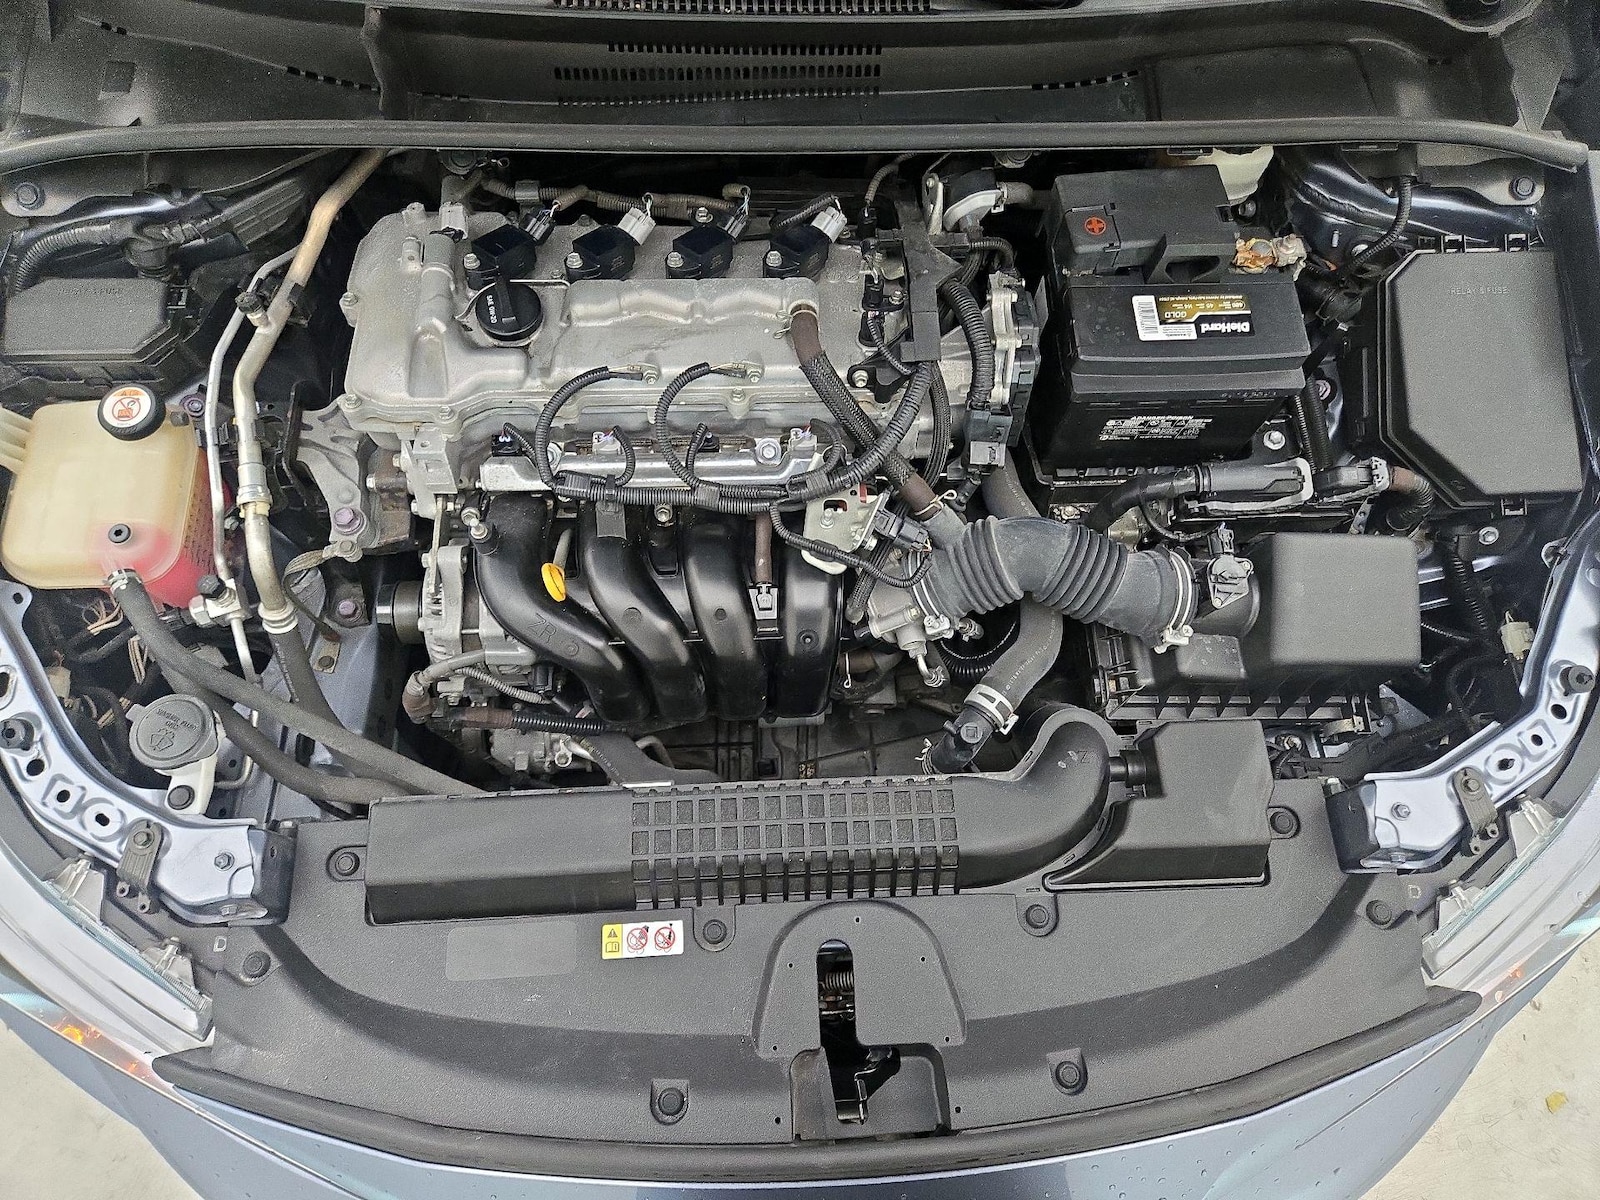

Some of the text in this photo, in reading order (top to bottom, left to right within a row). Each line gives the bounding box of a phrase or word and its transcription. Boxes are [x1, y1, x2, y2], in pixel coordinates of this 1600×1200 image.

[486, 294, 494, 306] SAE
[1164, 311, 1187, 319] GOLD
[1200, 321, 1250, 334] DieHard
